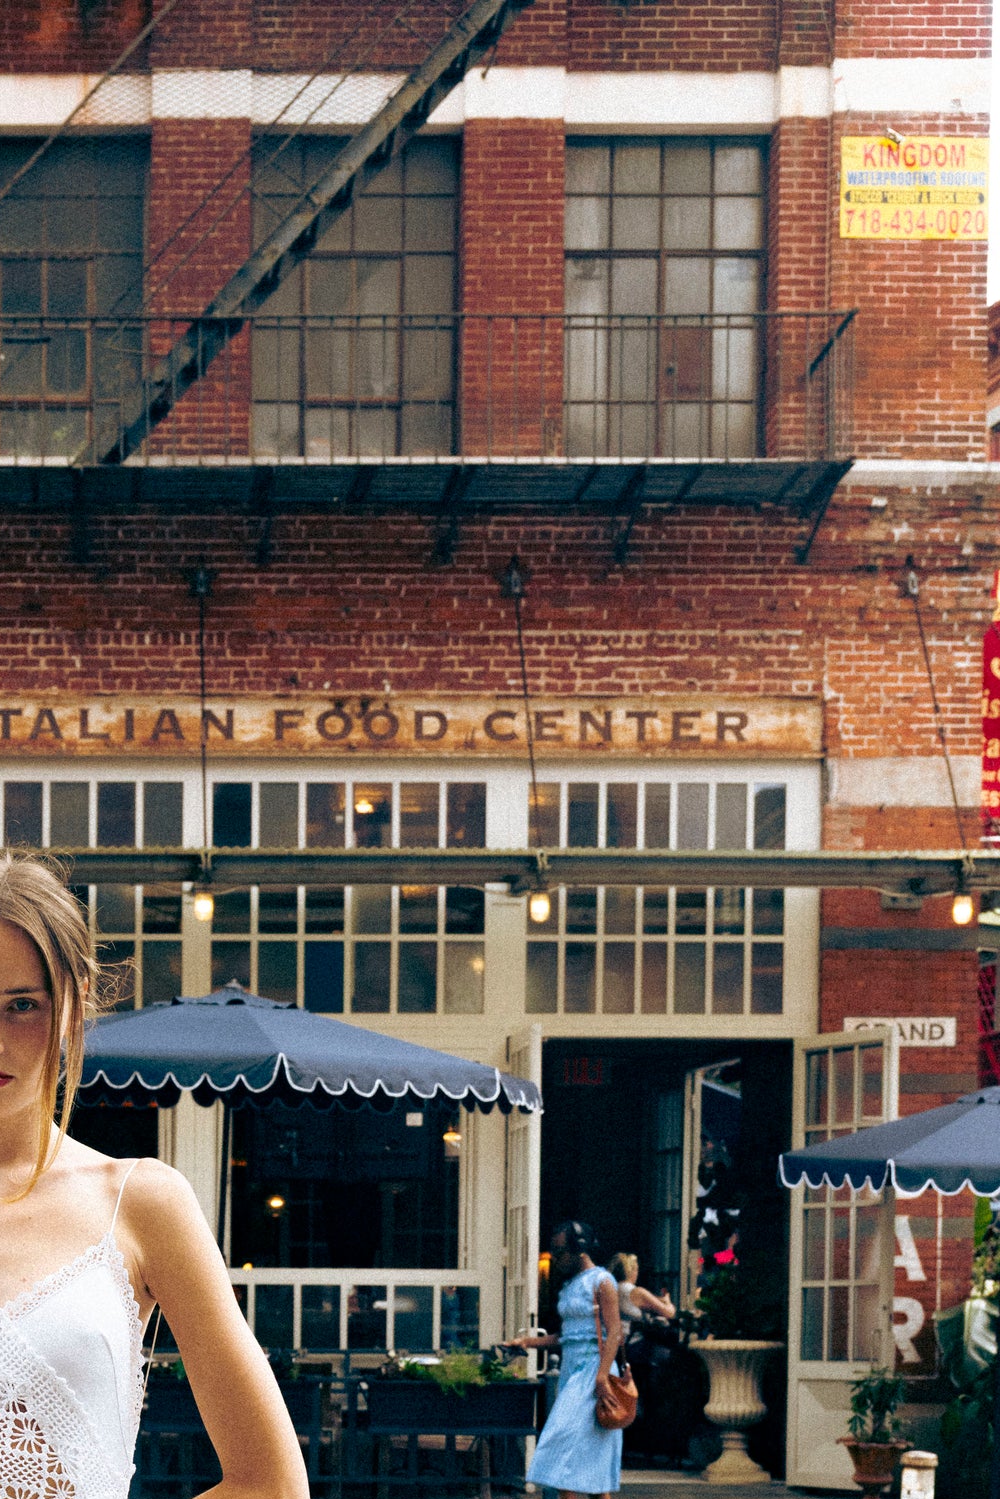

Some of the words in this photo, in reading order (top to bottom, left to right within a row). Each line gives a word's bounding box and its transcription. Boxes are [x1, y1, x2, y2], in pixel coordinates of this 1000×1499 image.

[863, 143, 966, 167] KINGDOM
[847, 171, 937, 187] WATERPROOFING
[940, 172, 985, 187] ROOFING
[845, 209, 985, 235] 718-434-0020
[275, 709, 447, 741] FOOD
[484, 710, 748, 742] CENTER
